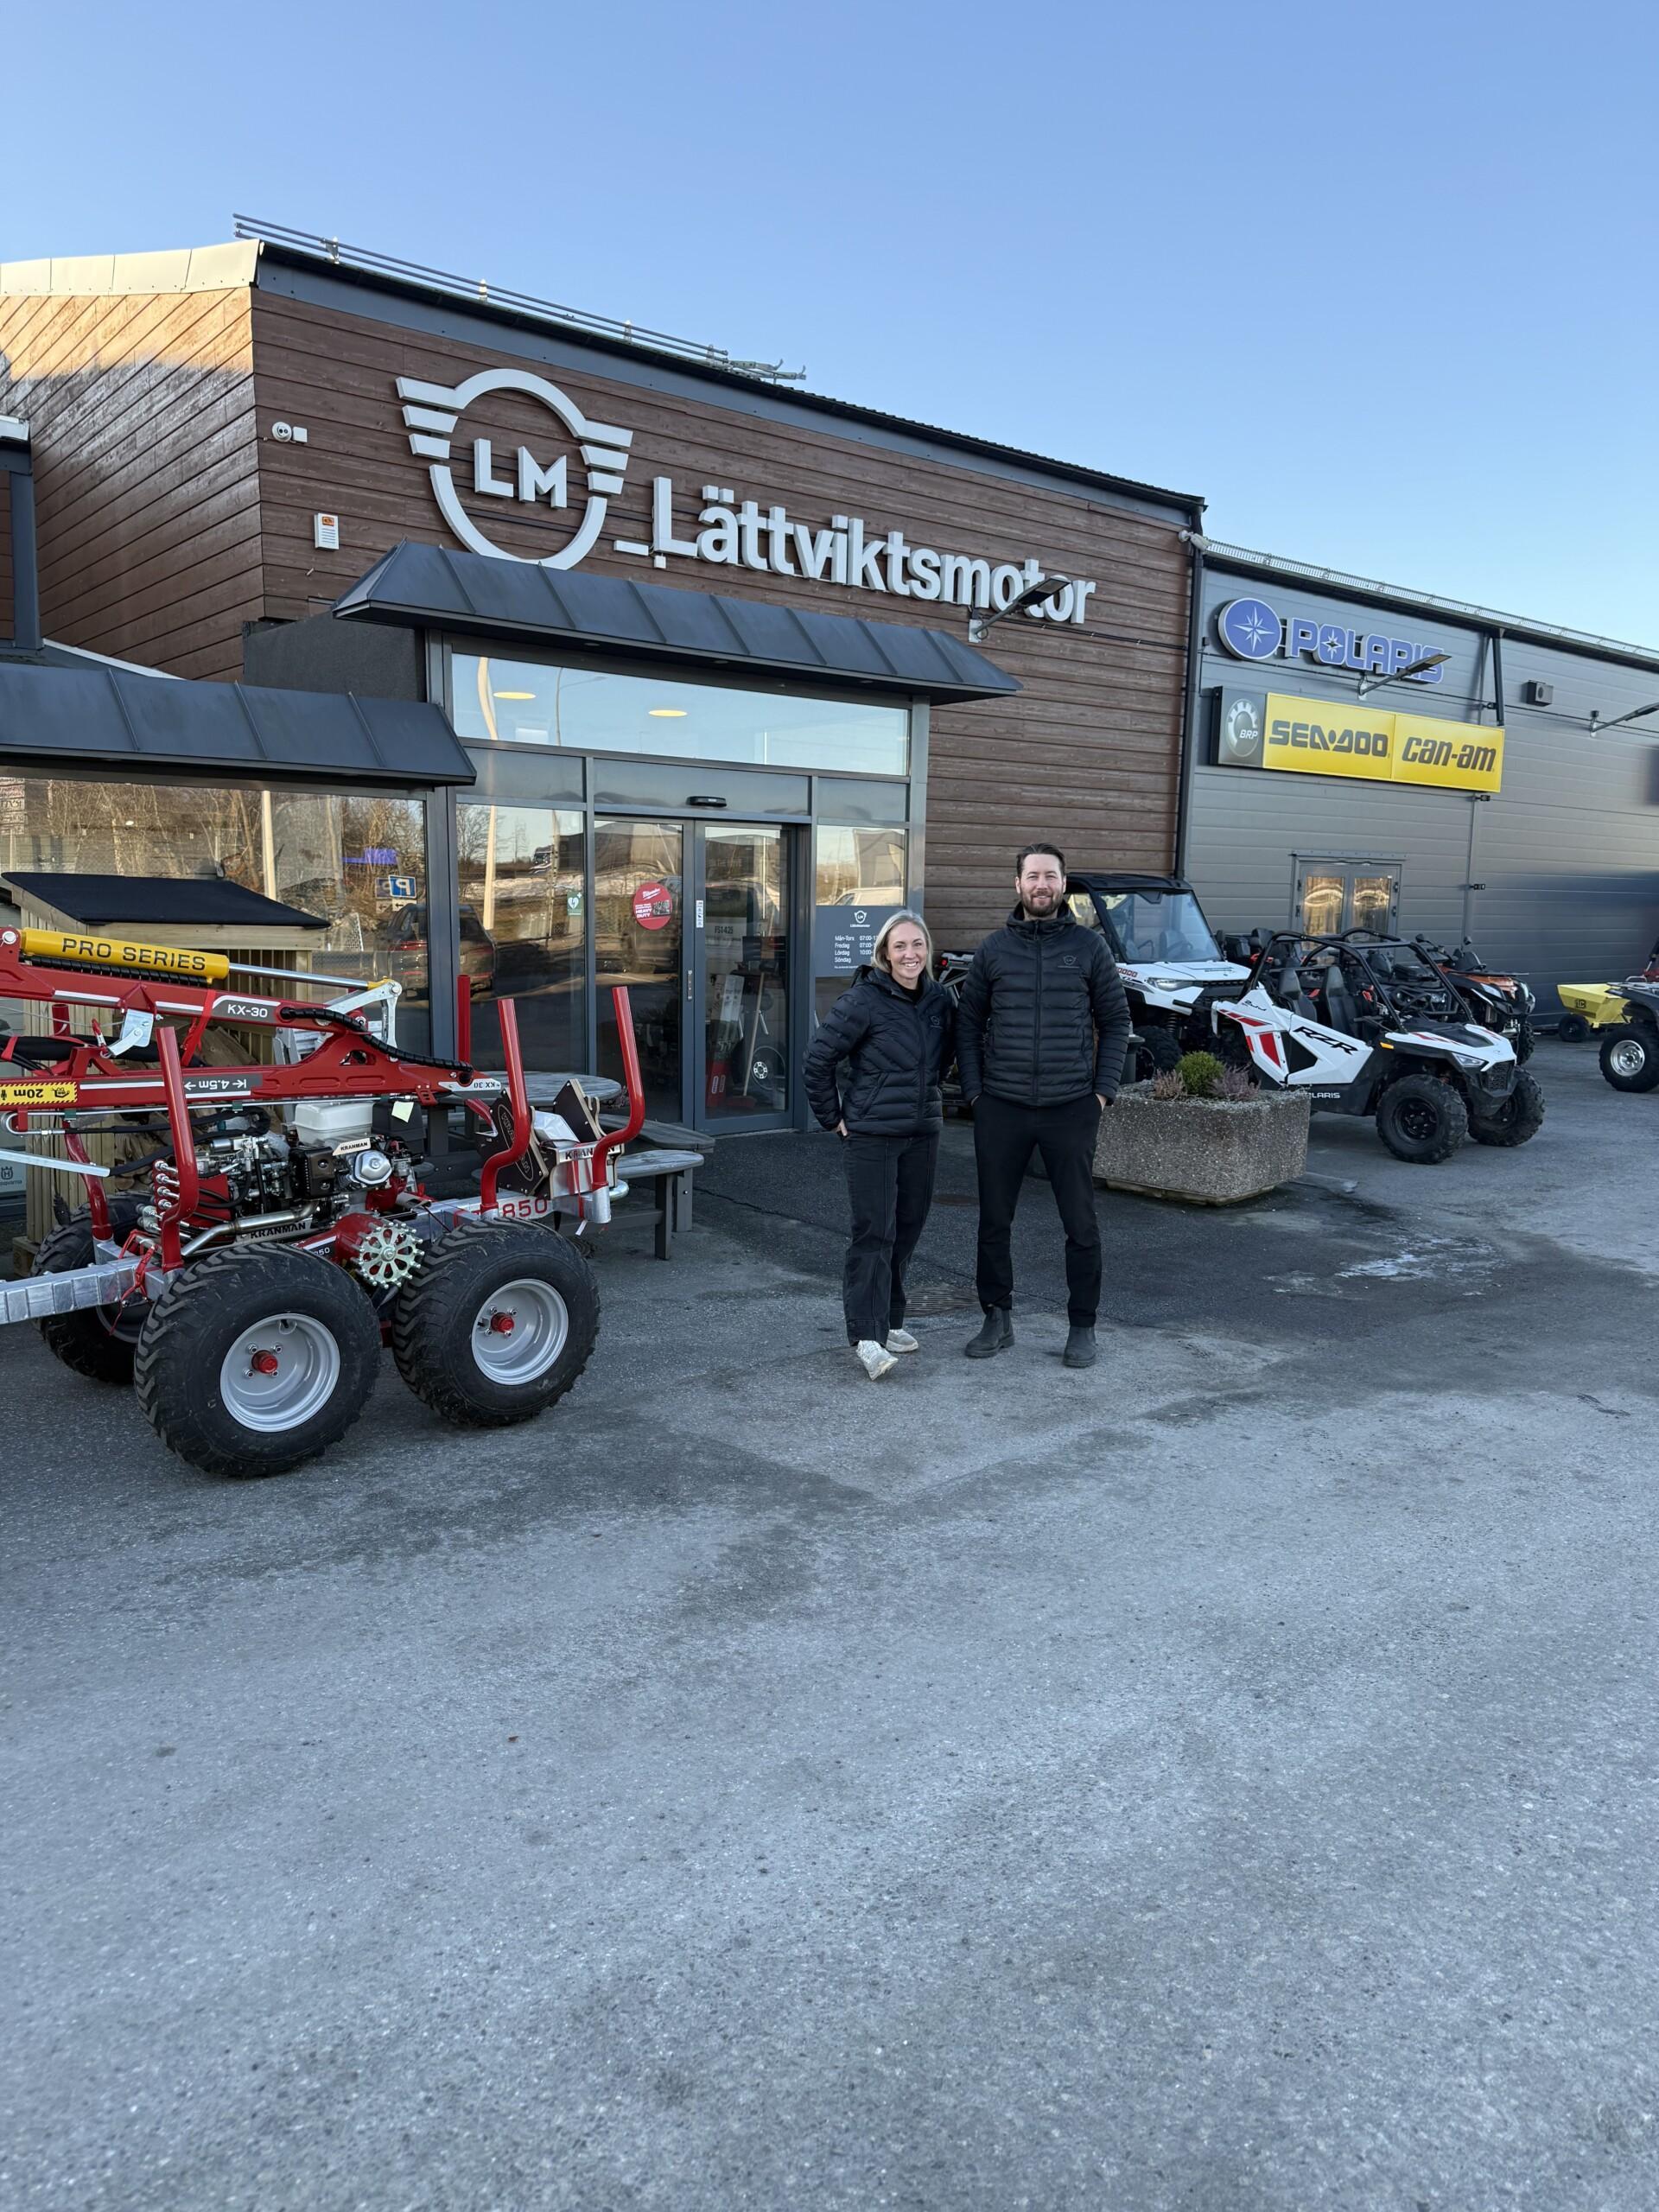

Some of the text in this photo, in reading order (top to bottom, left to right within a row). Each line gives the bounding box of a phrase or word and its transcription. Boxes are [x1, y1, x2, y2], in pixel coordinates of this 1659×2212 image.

[474, 438, 567, 508] LM
[653, 477, 1096, 624] Lättviktsmotor
[1286, 617, 1444, 683] POLARIS
[1239, 729, 1258, 740] BRP
[61, 938, 206, 971] PRO SERIES
[227, 1003, 268, 1018] KX-30
[1294, 1026, 1359, 1056] RZR
[198, 1079, 230, 1090] 4.5m
[13, 1088, 43, 1099] 20m
[340, 1141, 368, 1151] KRANMAN
[565, 1147, 615, 1160] KRANN
[502, 1198, 548, 1218] 850
[250, 1222, 307, 1239] KRANMAN
